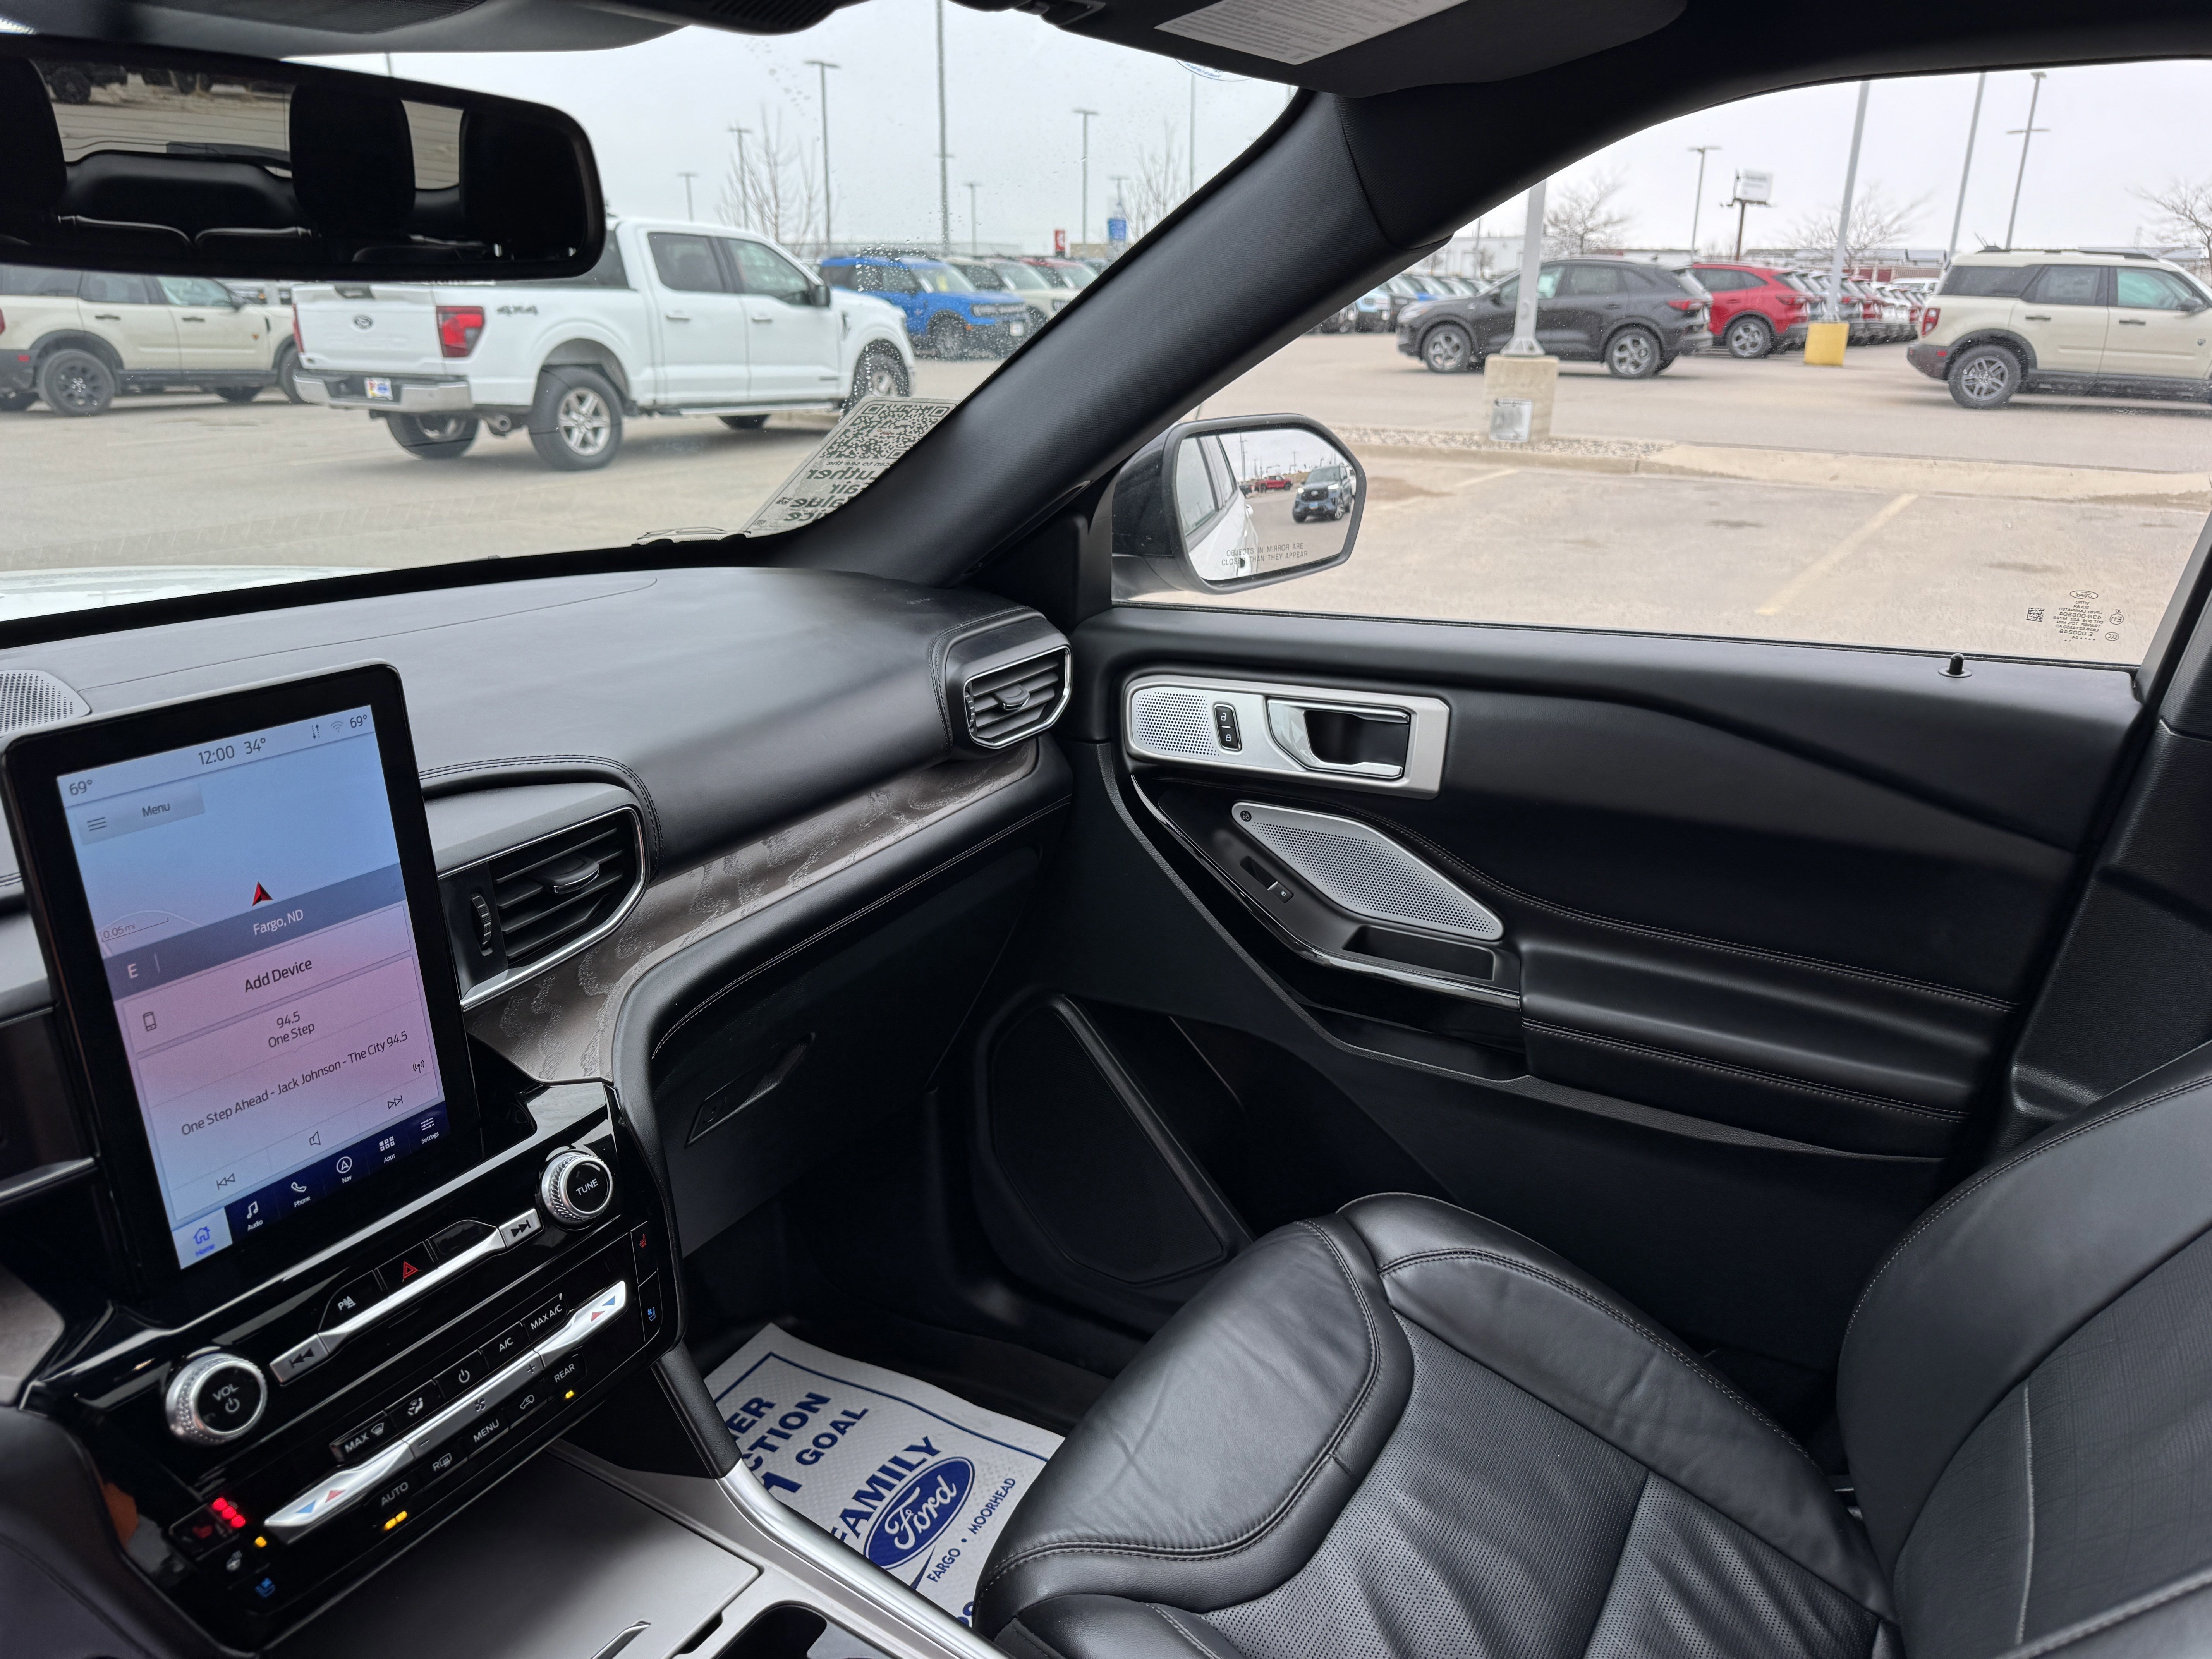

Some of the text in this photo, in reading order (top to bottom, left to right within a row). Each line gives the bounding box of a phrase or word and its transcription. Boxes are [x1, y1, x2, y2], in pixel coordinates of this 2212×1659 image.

[1226, 548, 1254, 557] OBJECTS
[350, 714, 368, 728] 69°
[198, 737, 266, 765] 12:00 34°
[69, 779, 93, 796] 69°
[142, 803, 170, 817] Menu
[253, 909, 304, 936] Fargo, ND
[127, 963, 139, 979] E
[245, 960, 312, 993] Add Device
[276, 1011, 300, 1029] 94.5
[268, 1023, 315, 1048] One Step
[181, 1120, 205, 1135] One
[206, 1107, 233, 1125] Step
[234, 1091, 269, 1113] Ahead
[277, 1078, 299, 1096] Jack
[301, 1061, 341, 1085] Johnson
[348, 1049, 366, 1064] The
[368, 1040, 385, 1055] City
[386, 1030, 407, 1047] 94.5
[421, 1130, 439, 1144] Settings
[383, 1153, 396, 1163] Apps
[342, 1175, 352, 1183] Nav
[576, 1178, 599, 1196] TUNE
[294, 1196, 311, 1207] Phone
[247, 1219, 263, 1231] Audio
[196, 1243, 215, 1257] Home
[530, 1303, 563, 1330] MAX A/C
[498, 1337, 514, 1352] A/C
[554, 1363, 575, 1382] REAR
[212, 1384, 240, 1401] VOL
[725, 1397, 776, 1441] ER
[473, 1419, 500, 1443] MENU
[795, 1408, 869, 1465] GOAL
[344, 1432, 370, 1453] MAX
[380, 1482, 409, 1506] AUTO
[884, 1474, 957, 1549] Ford
[927, 1477, 1016, 1582] FARGO MOORHEAD
